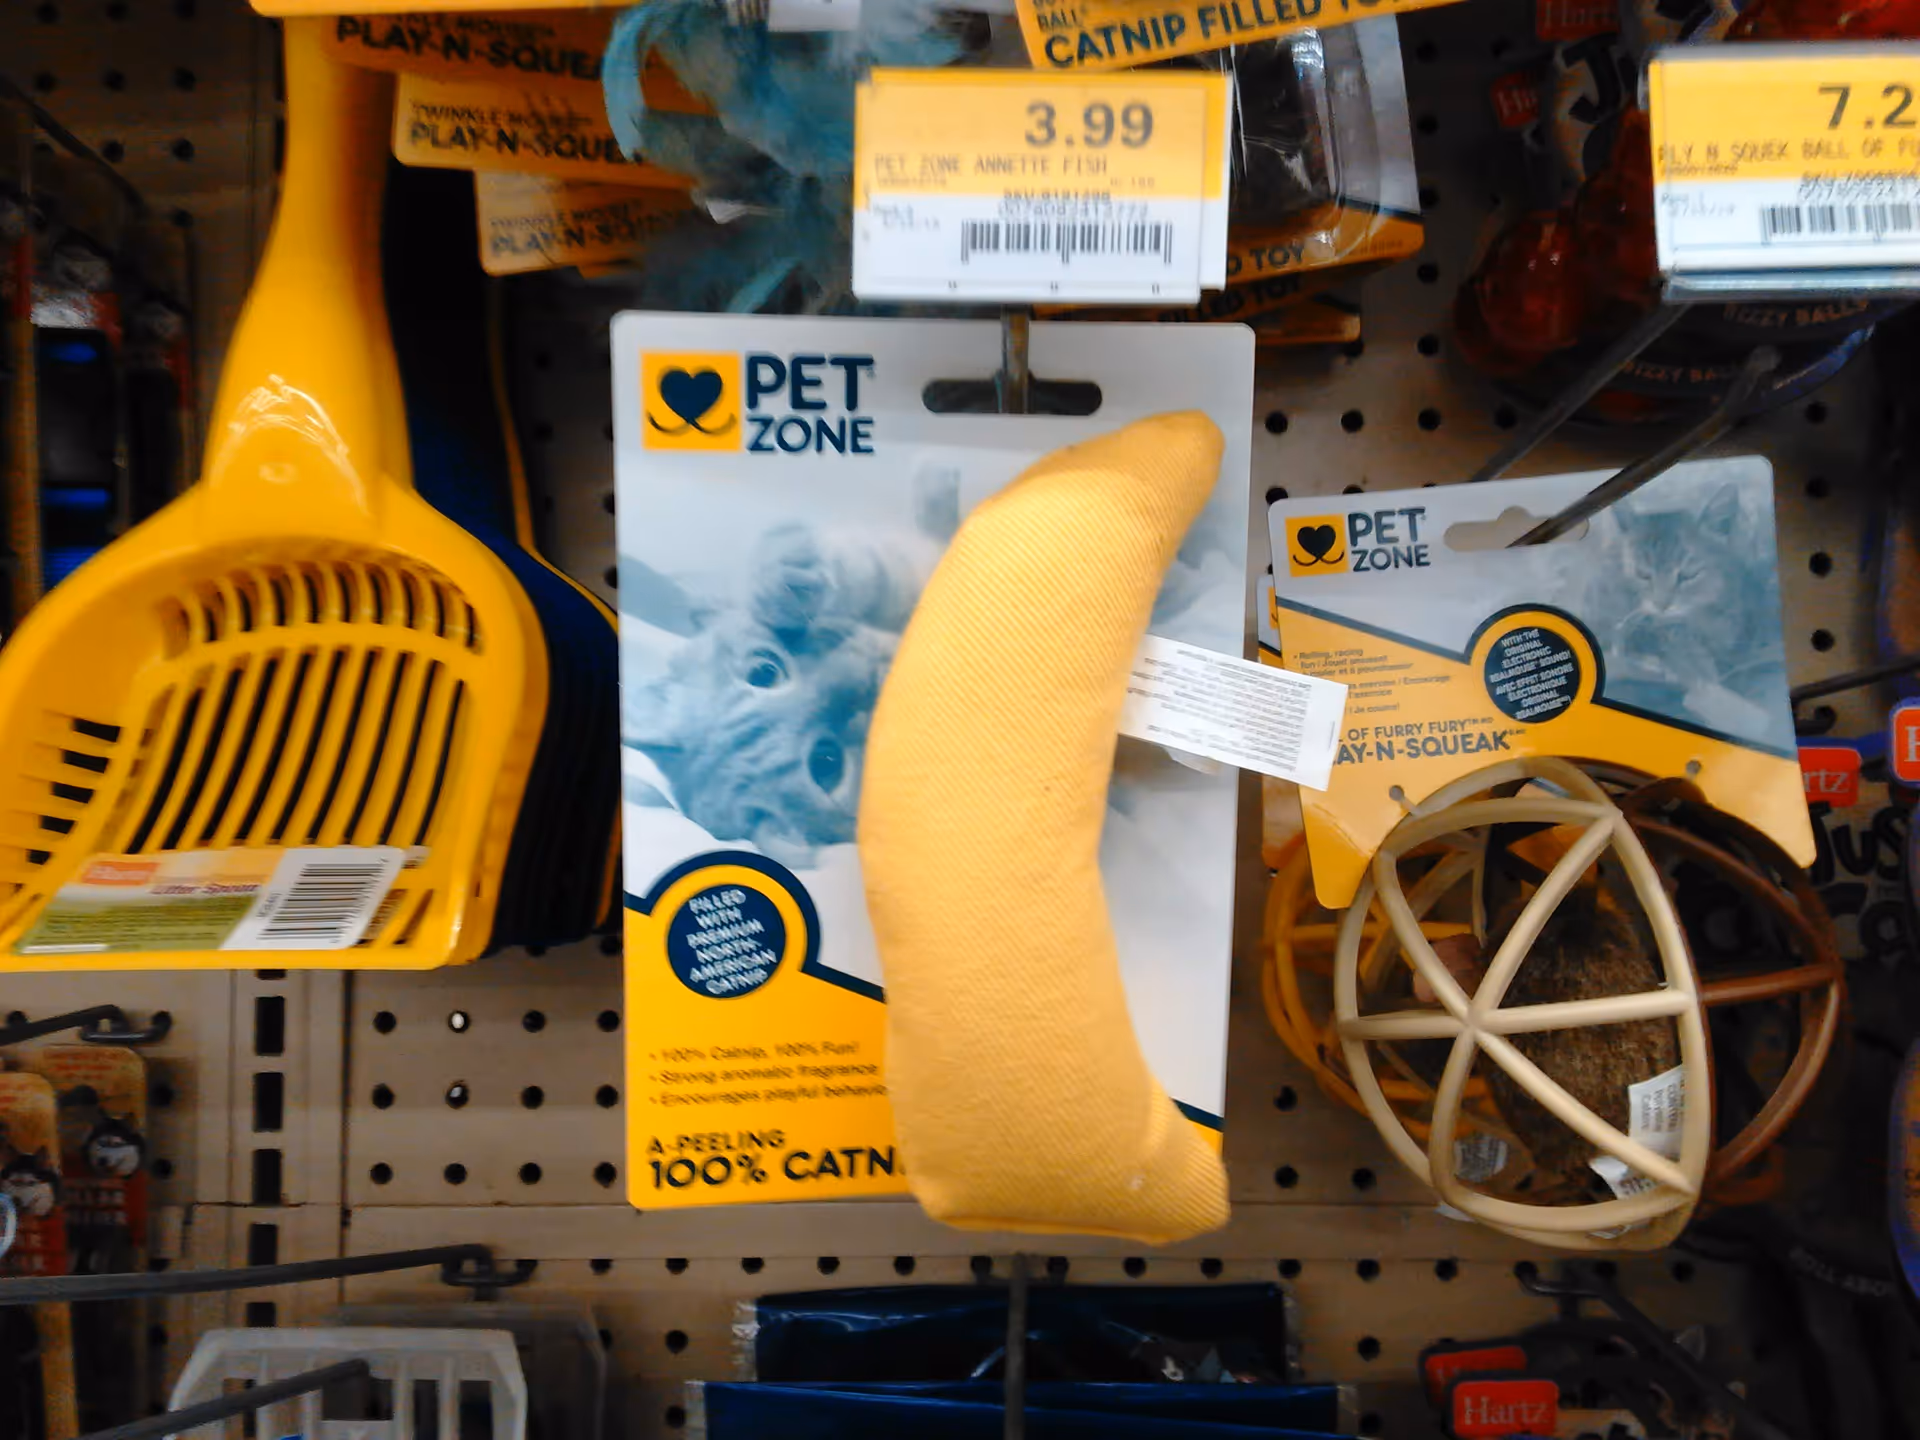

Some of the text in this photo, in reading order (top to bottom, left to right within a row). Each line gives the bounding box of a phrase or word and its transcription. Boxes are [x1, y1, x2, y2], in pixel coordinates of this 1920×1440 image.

[337, 15, 604, 81] PLAY-N-SQUE
[1044, 0, 1322, 68] CATNIP FILLED
[1024, 100, 1154, 148] 3.99
[974, 155, 1049, 176] ANNETTE
[1249, 241, 1305, 271] TOY
[745, 352, 874, 411] PET
[746, 415, 875, 455] ZONE
[1347, 507, 1427, 546] PET
[1352, 544, 1432, 572] ZONE
[1334, 730, 1511, 766] AY-N-SQUEAK
[1347, 727, 1369, 742] OF
[1374, 721, 1423, 741] FURRY
[1803, 766, 1850, 793] rtz
[695, 906, 743, 930] WITH
[690, 948, 777, 983] AMERICAN
[649, 1145, 904, 1190] 100% CATN
[1464, 1396, 1551, 1426] Hartz
